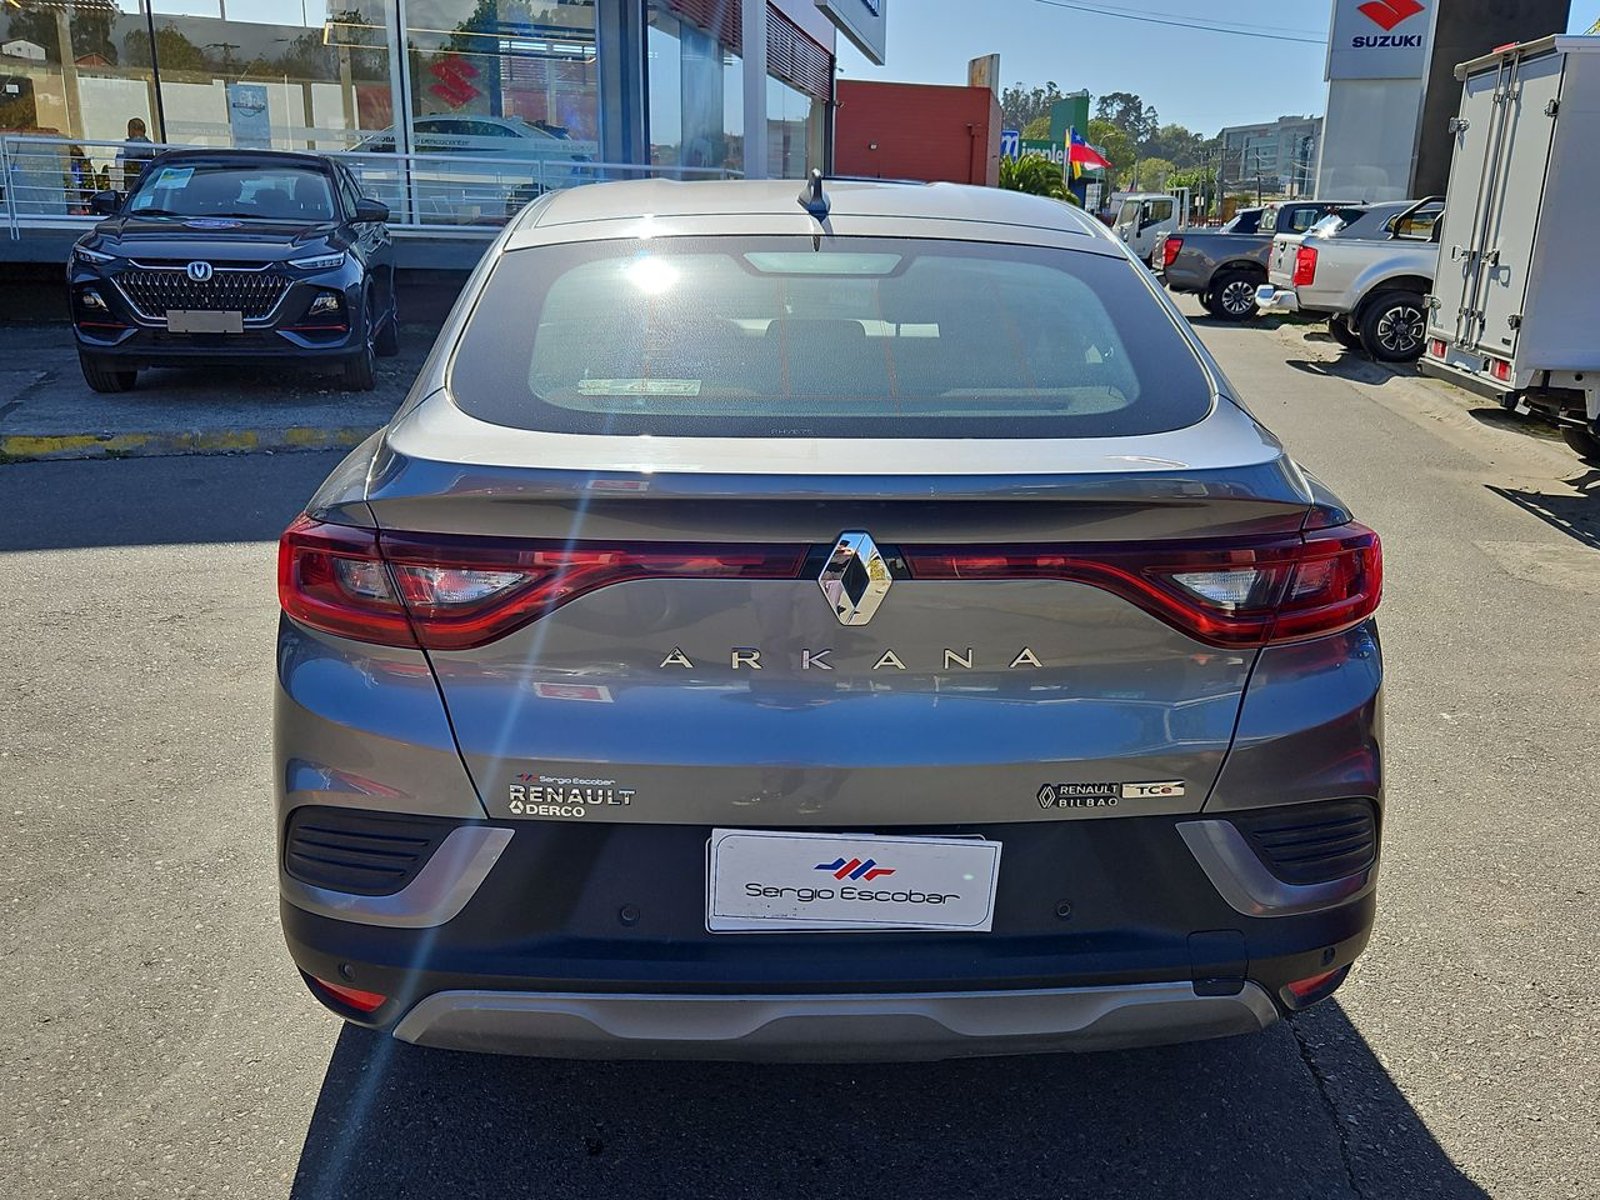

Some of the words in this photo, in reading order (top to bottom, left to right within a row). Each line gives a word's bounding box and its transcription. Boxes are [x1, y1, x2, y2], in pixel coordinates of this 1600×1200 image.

[1352, 35, 1422, 48] SUZUKI
[660, 645, 1043, 671] ARKANA
[539, 775, 572, 785] Sergio
[573, 778, 616, 786] Escobar
[509, 784, 636, 806] RENAULT
[1059, 784, 1119, 796] RENAULT
[1136, 786, 1173, 796] TCe
[1058, 797, 1119, 808] BILBAO
[525, 804, 586, 818] DERCO
[745, 883, 835, 902] Sergio
[840, 887, 960, 905] Escobar
